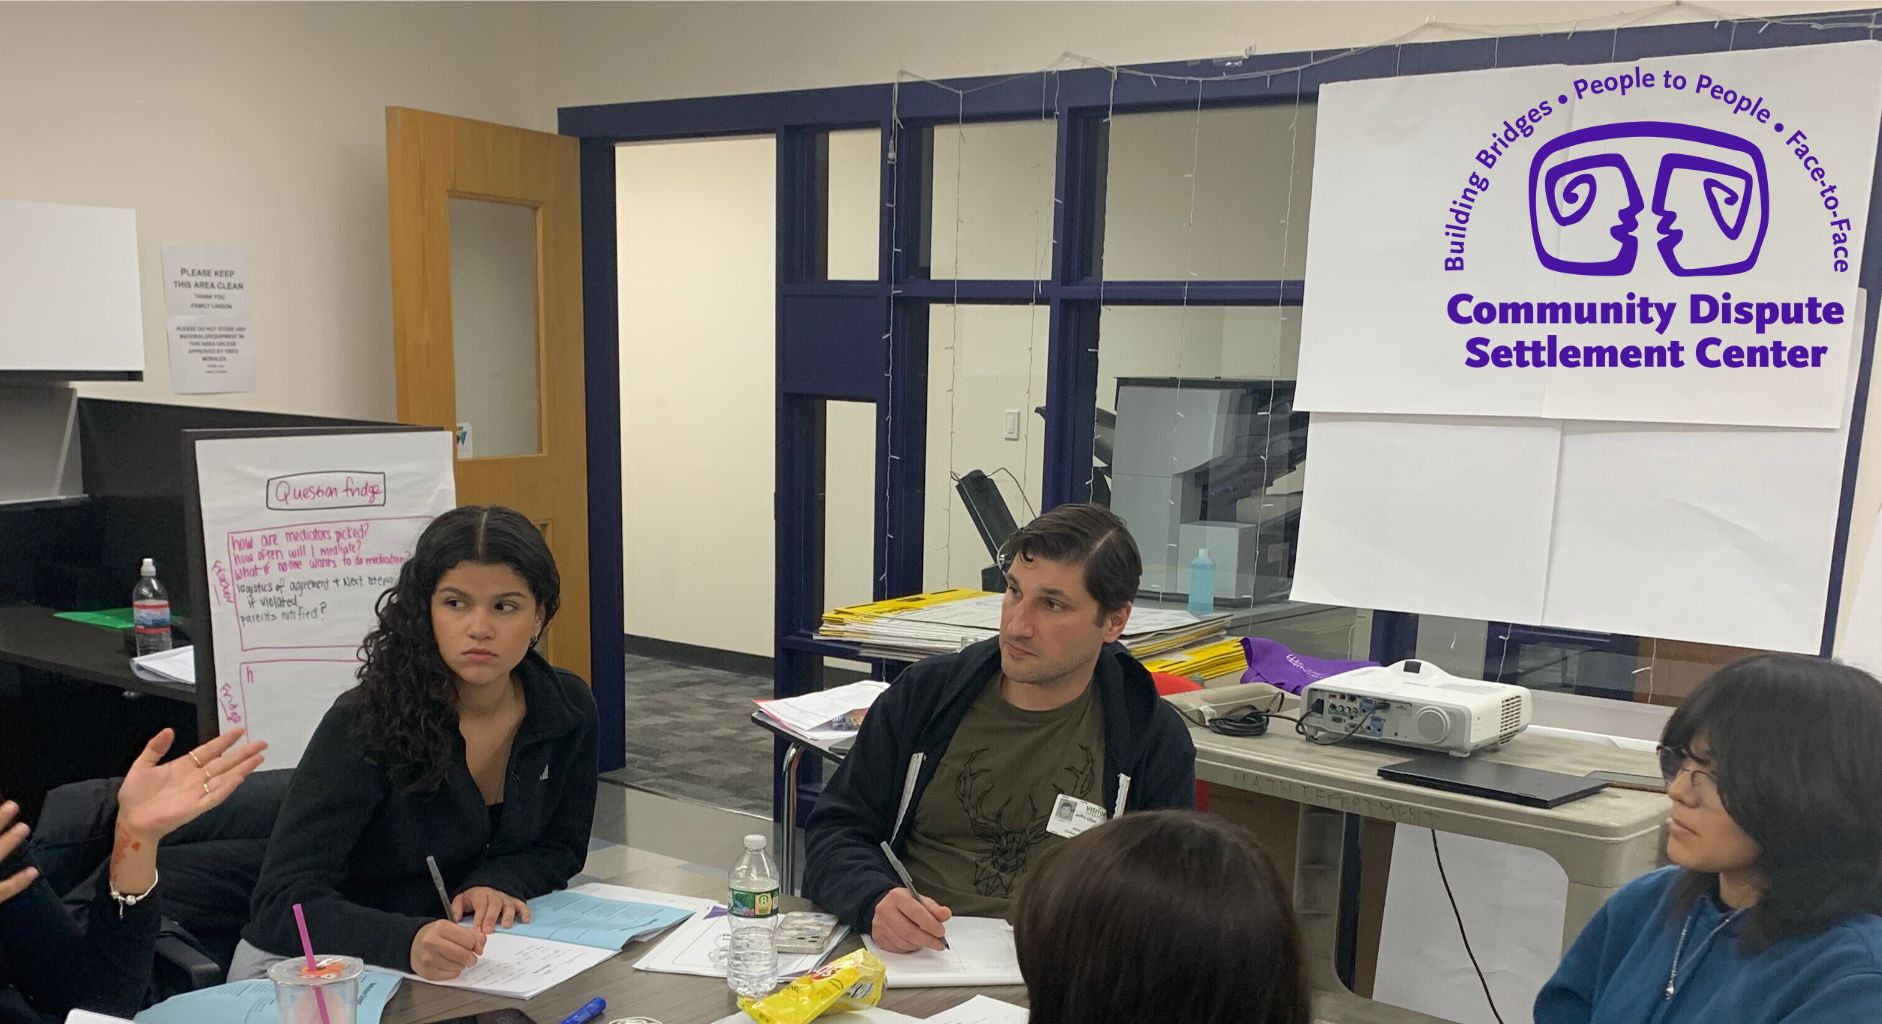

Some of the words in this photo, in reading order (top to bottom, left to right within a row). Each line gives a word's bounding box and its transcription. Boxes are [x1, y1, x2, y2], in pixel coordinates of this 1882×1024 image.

[180, 267, 212, 278] PLEASE
[213, 269, 236, 278] KEEP
[173, 280, 192, 289] THIS
[194, 281, 215, 290] AREA
[217, 282, 244, 290] CLEAN
[275, 480, 338, 505] Question
[342, 476, 383, 503] fridge
[231, 536, 254, 553] how
[261, 534, 278, 547] are
[285, 528, 332, 542] mediators
[335, 522, 369, 546] picked?
[233, 552, 254, 566] how
[257, 549, 284, 561] often
[288, 545, 306, 558] will
[309, 557, 337, 569] wants
[342, 554, 352, 566] to
[354, 555, 363, 566] do
[236, 582, 273, 599] logistics
[290, 579, 329, 597] agreement
[260, 595, 297, 608] violated
[239, 612, 277, 627] parents
